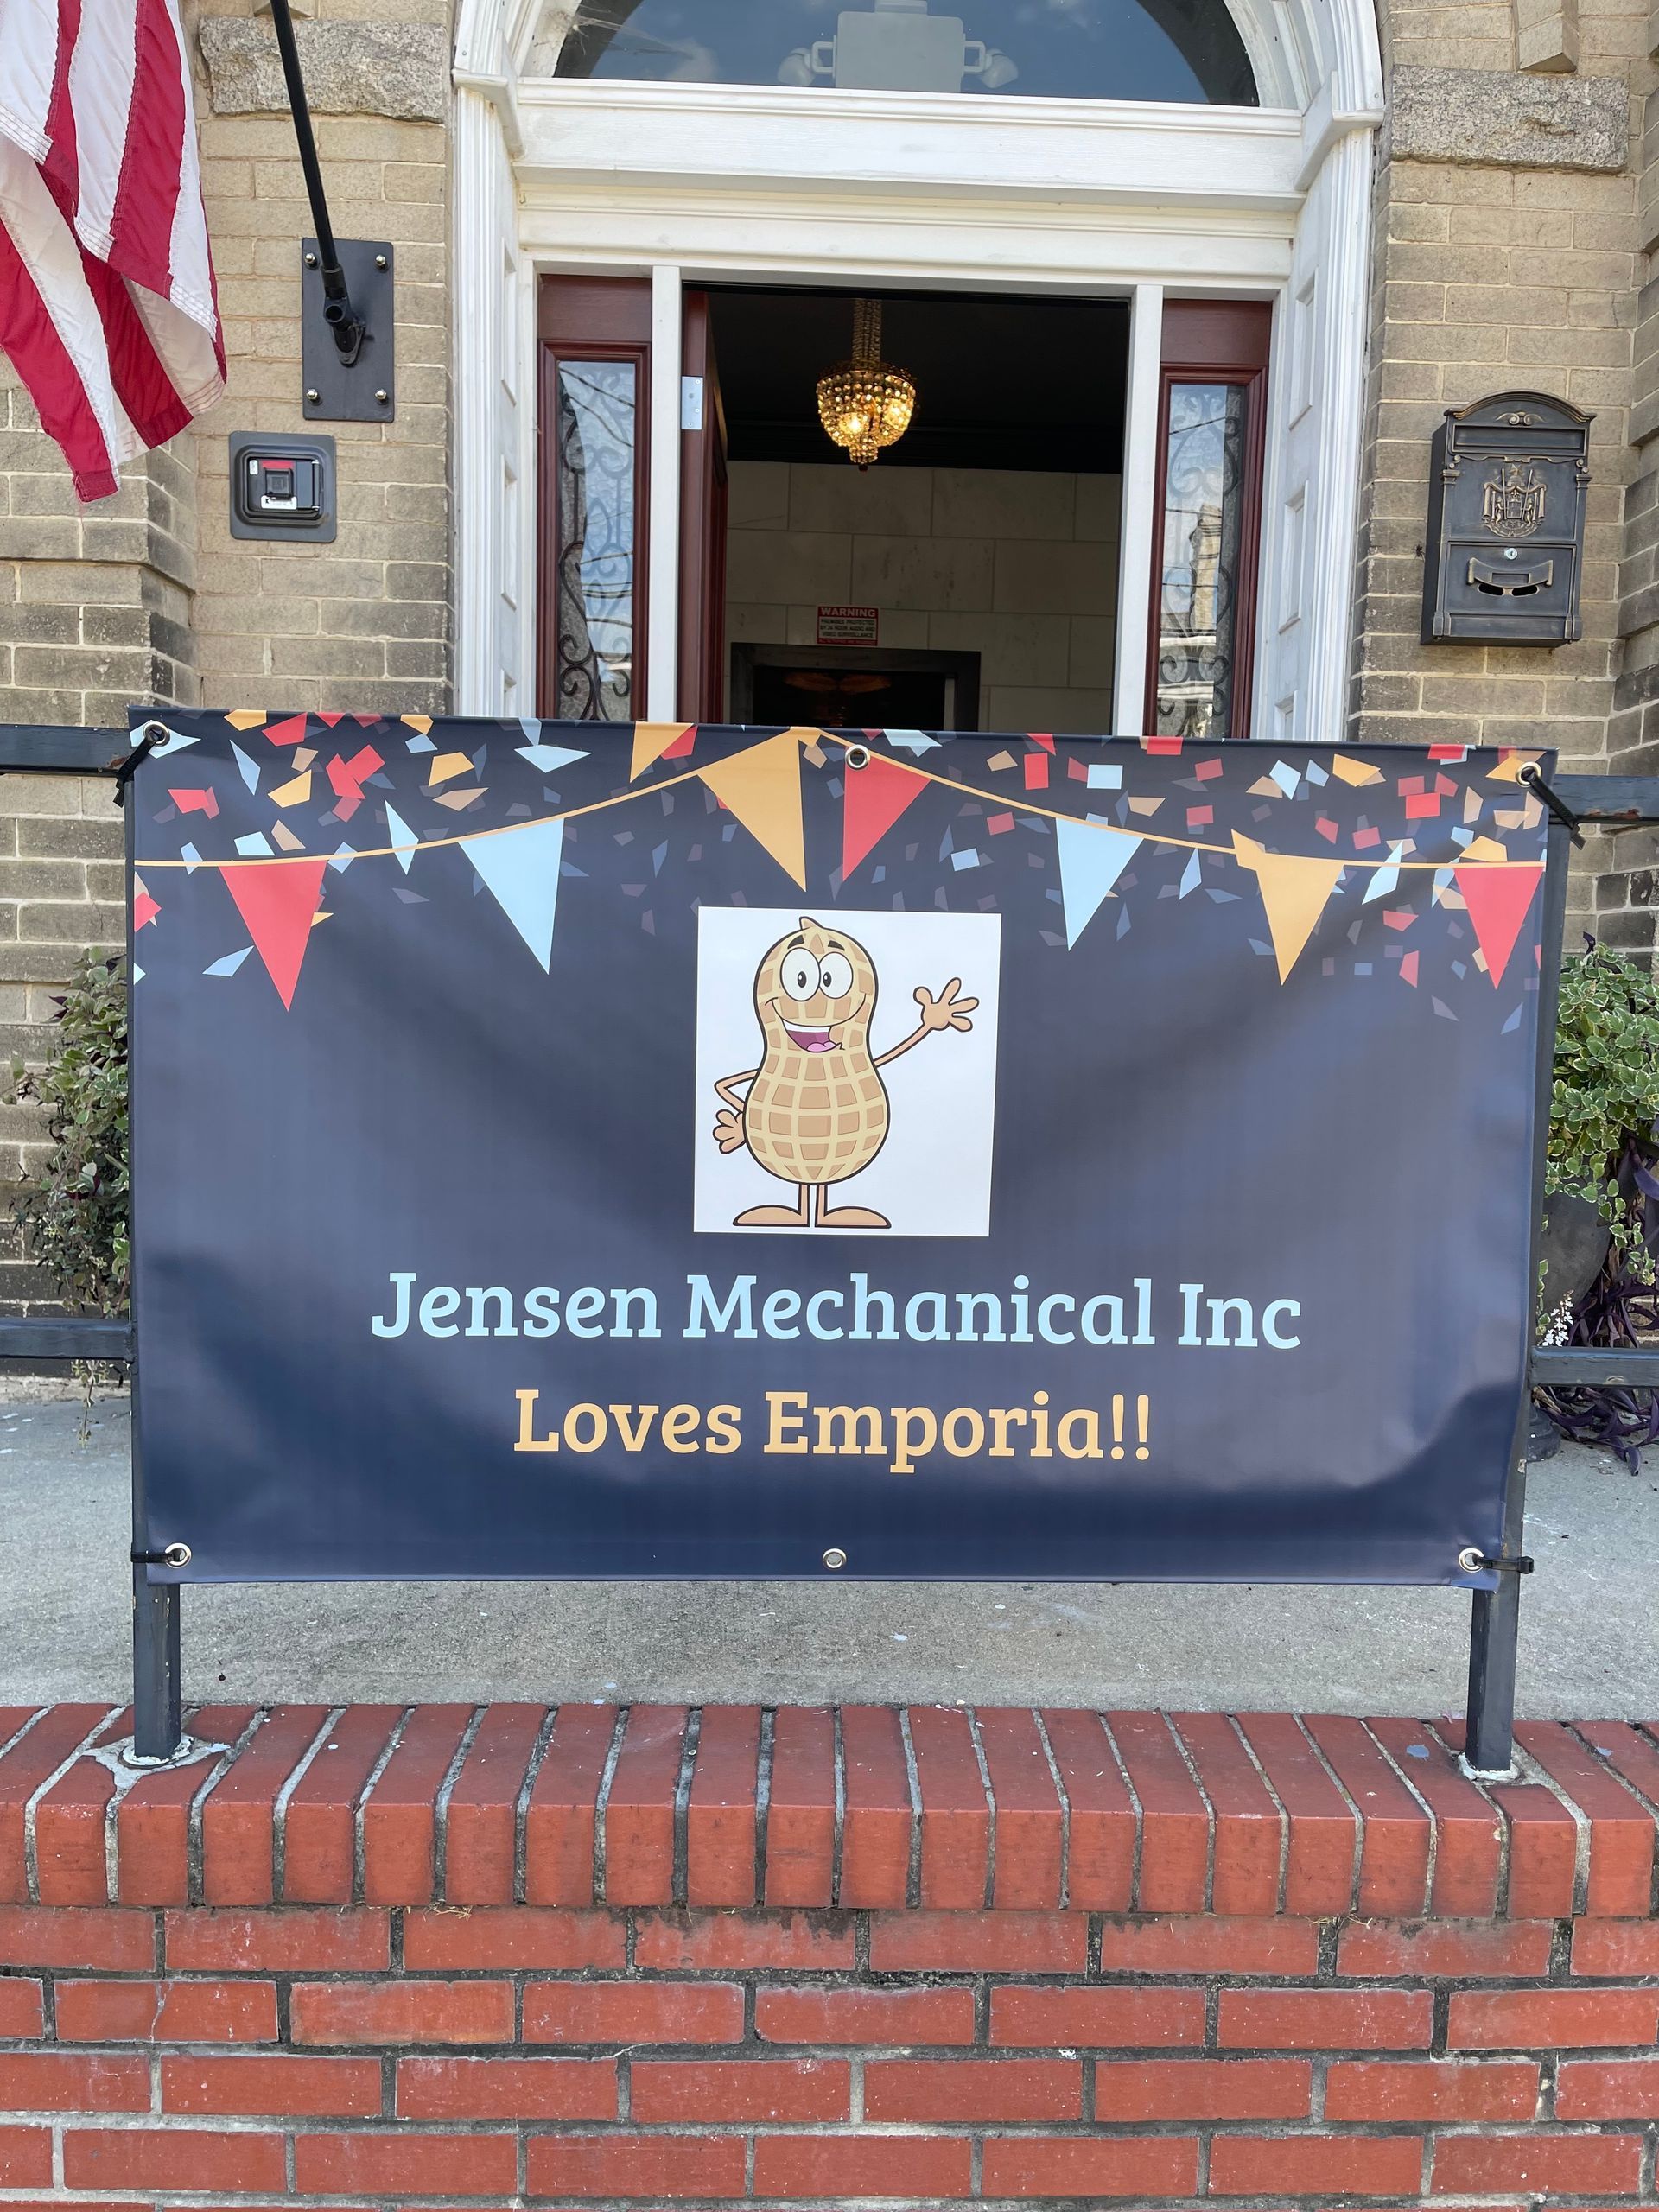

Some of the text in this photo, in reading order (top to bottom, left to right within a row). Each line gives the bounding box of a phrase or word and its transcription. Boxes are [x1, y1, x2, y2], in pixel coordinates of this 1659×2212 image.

[821, 607, 876, 617] WARNING
[372, 1272, 1302, 1350] Jensen Mechanical Inc
[513, 1389, 1151, 1474] Loves Emporia!!
